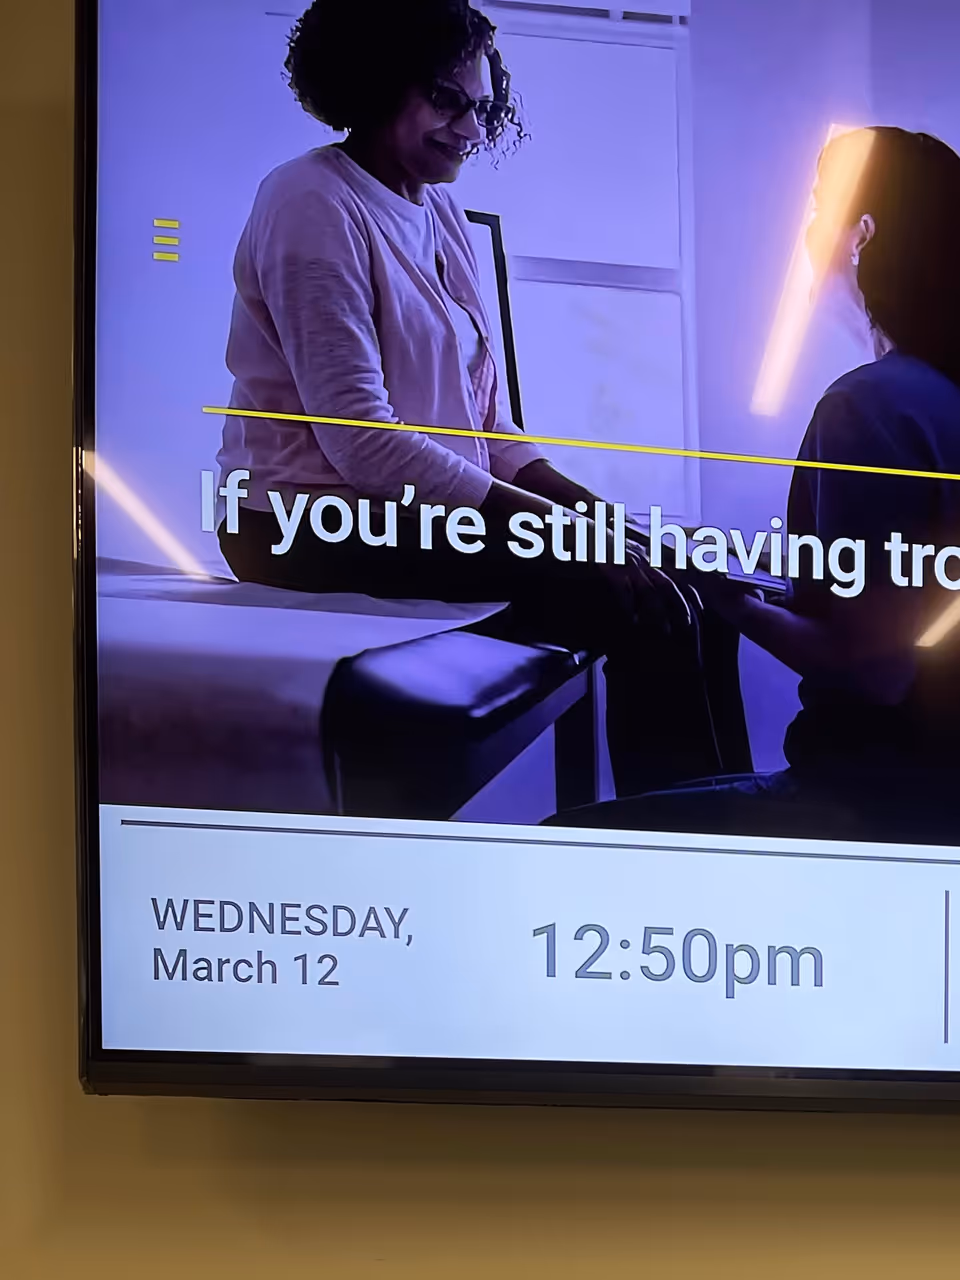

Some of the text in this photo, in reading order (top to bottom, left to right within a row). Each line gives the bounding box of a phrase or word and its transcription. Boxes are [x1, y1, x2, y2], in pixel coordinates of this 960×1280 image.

[200, 469, 252, 535] If
[269, 484, 487, 556] you’re
[506, 500, 626, 565] still
[649, 505, 867, 599] having
[150, 896, 415, 948] WEDNESDAY,
[152, 947, 341, 987] March 12
[531, 921, 825, 1000] 12:50pm
